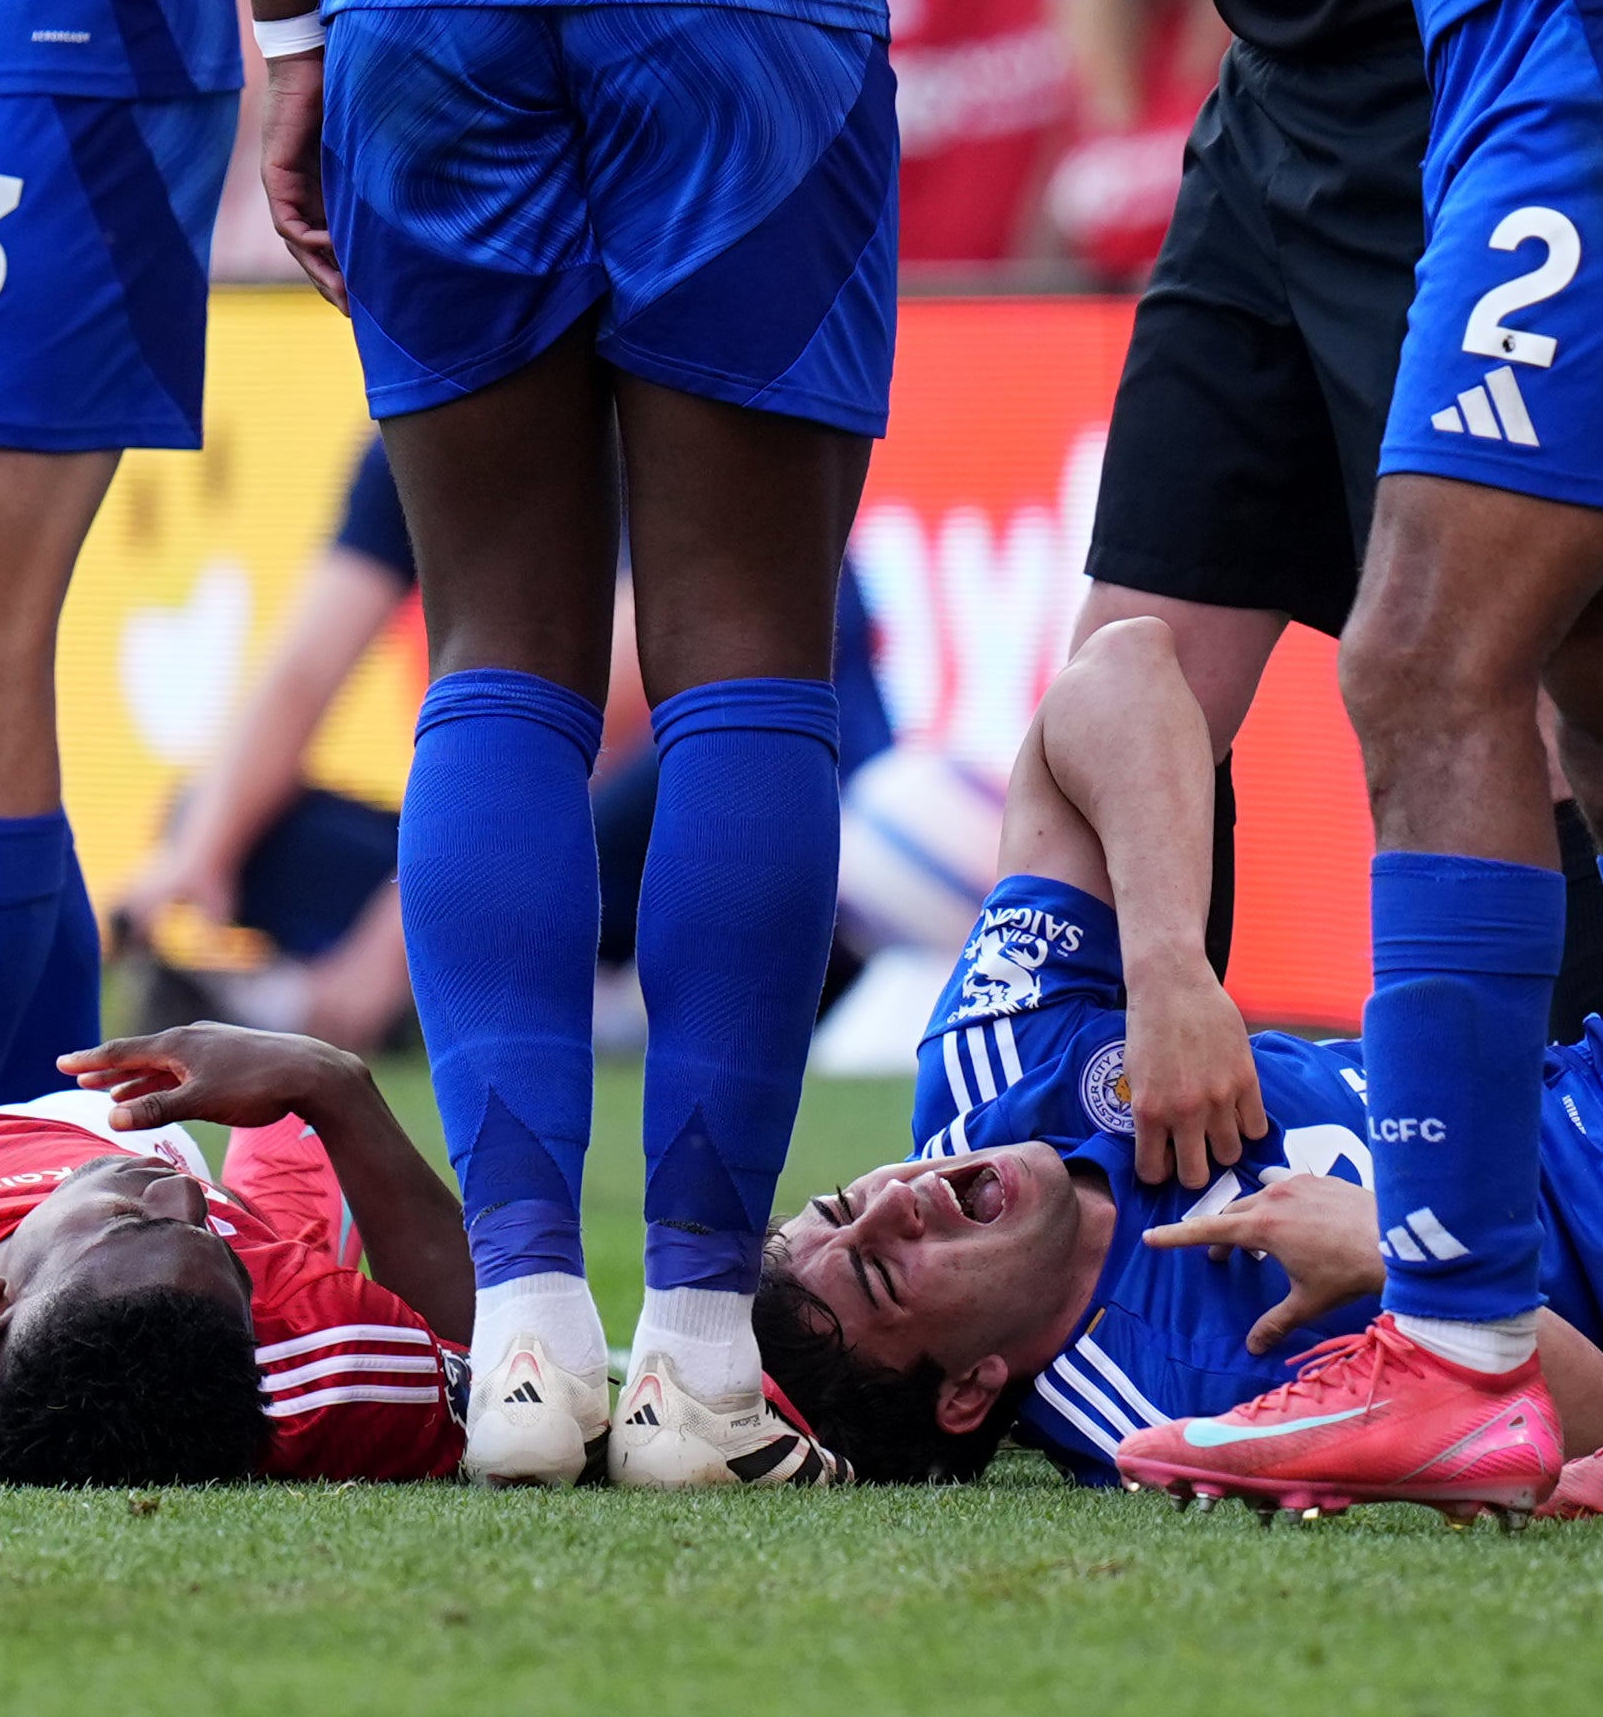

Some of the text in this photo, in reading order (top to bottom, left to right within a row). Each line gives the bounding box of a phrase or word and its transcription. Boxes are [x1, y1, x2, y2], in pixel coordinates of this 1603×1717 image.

[1461, 206, 1583, 367] 2
[1000, 927, 1037, 944] BIA
[1090, 1056, 1135, 1129] EICESTER CITY
[1368, 1116, 1447, 1143] LCFC
